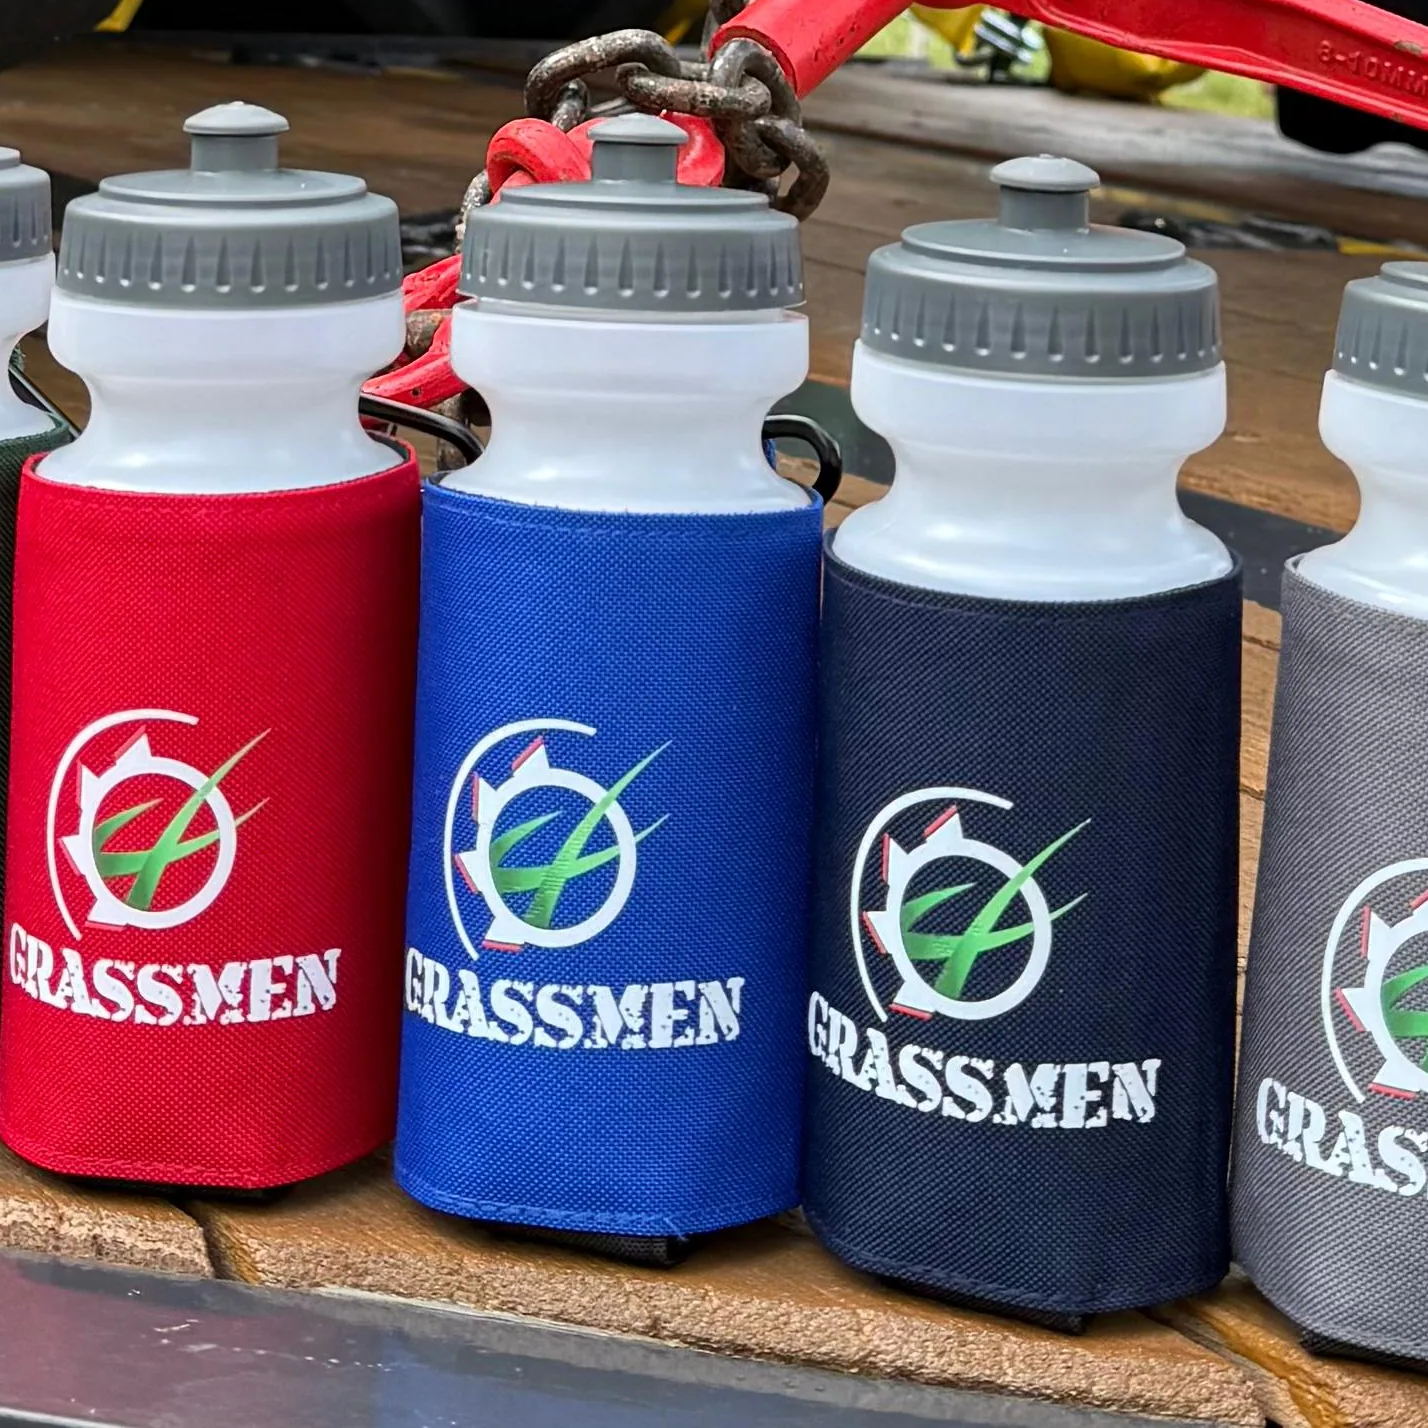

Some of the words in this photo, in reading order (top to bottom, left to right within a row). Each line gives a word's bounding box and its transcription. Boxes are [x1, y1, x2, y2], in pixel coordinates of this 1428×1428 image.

[9, 922, 342, 1026] GRASSMEN
[404, 946, 746, 1050] GRASSMEN
[807, 990, 1162, 1129] GRASSMEN
